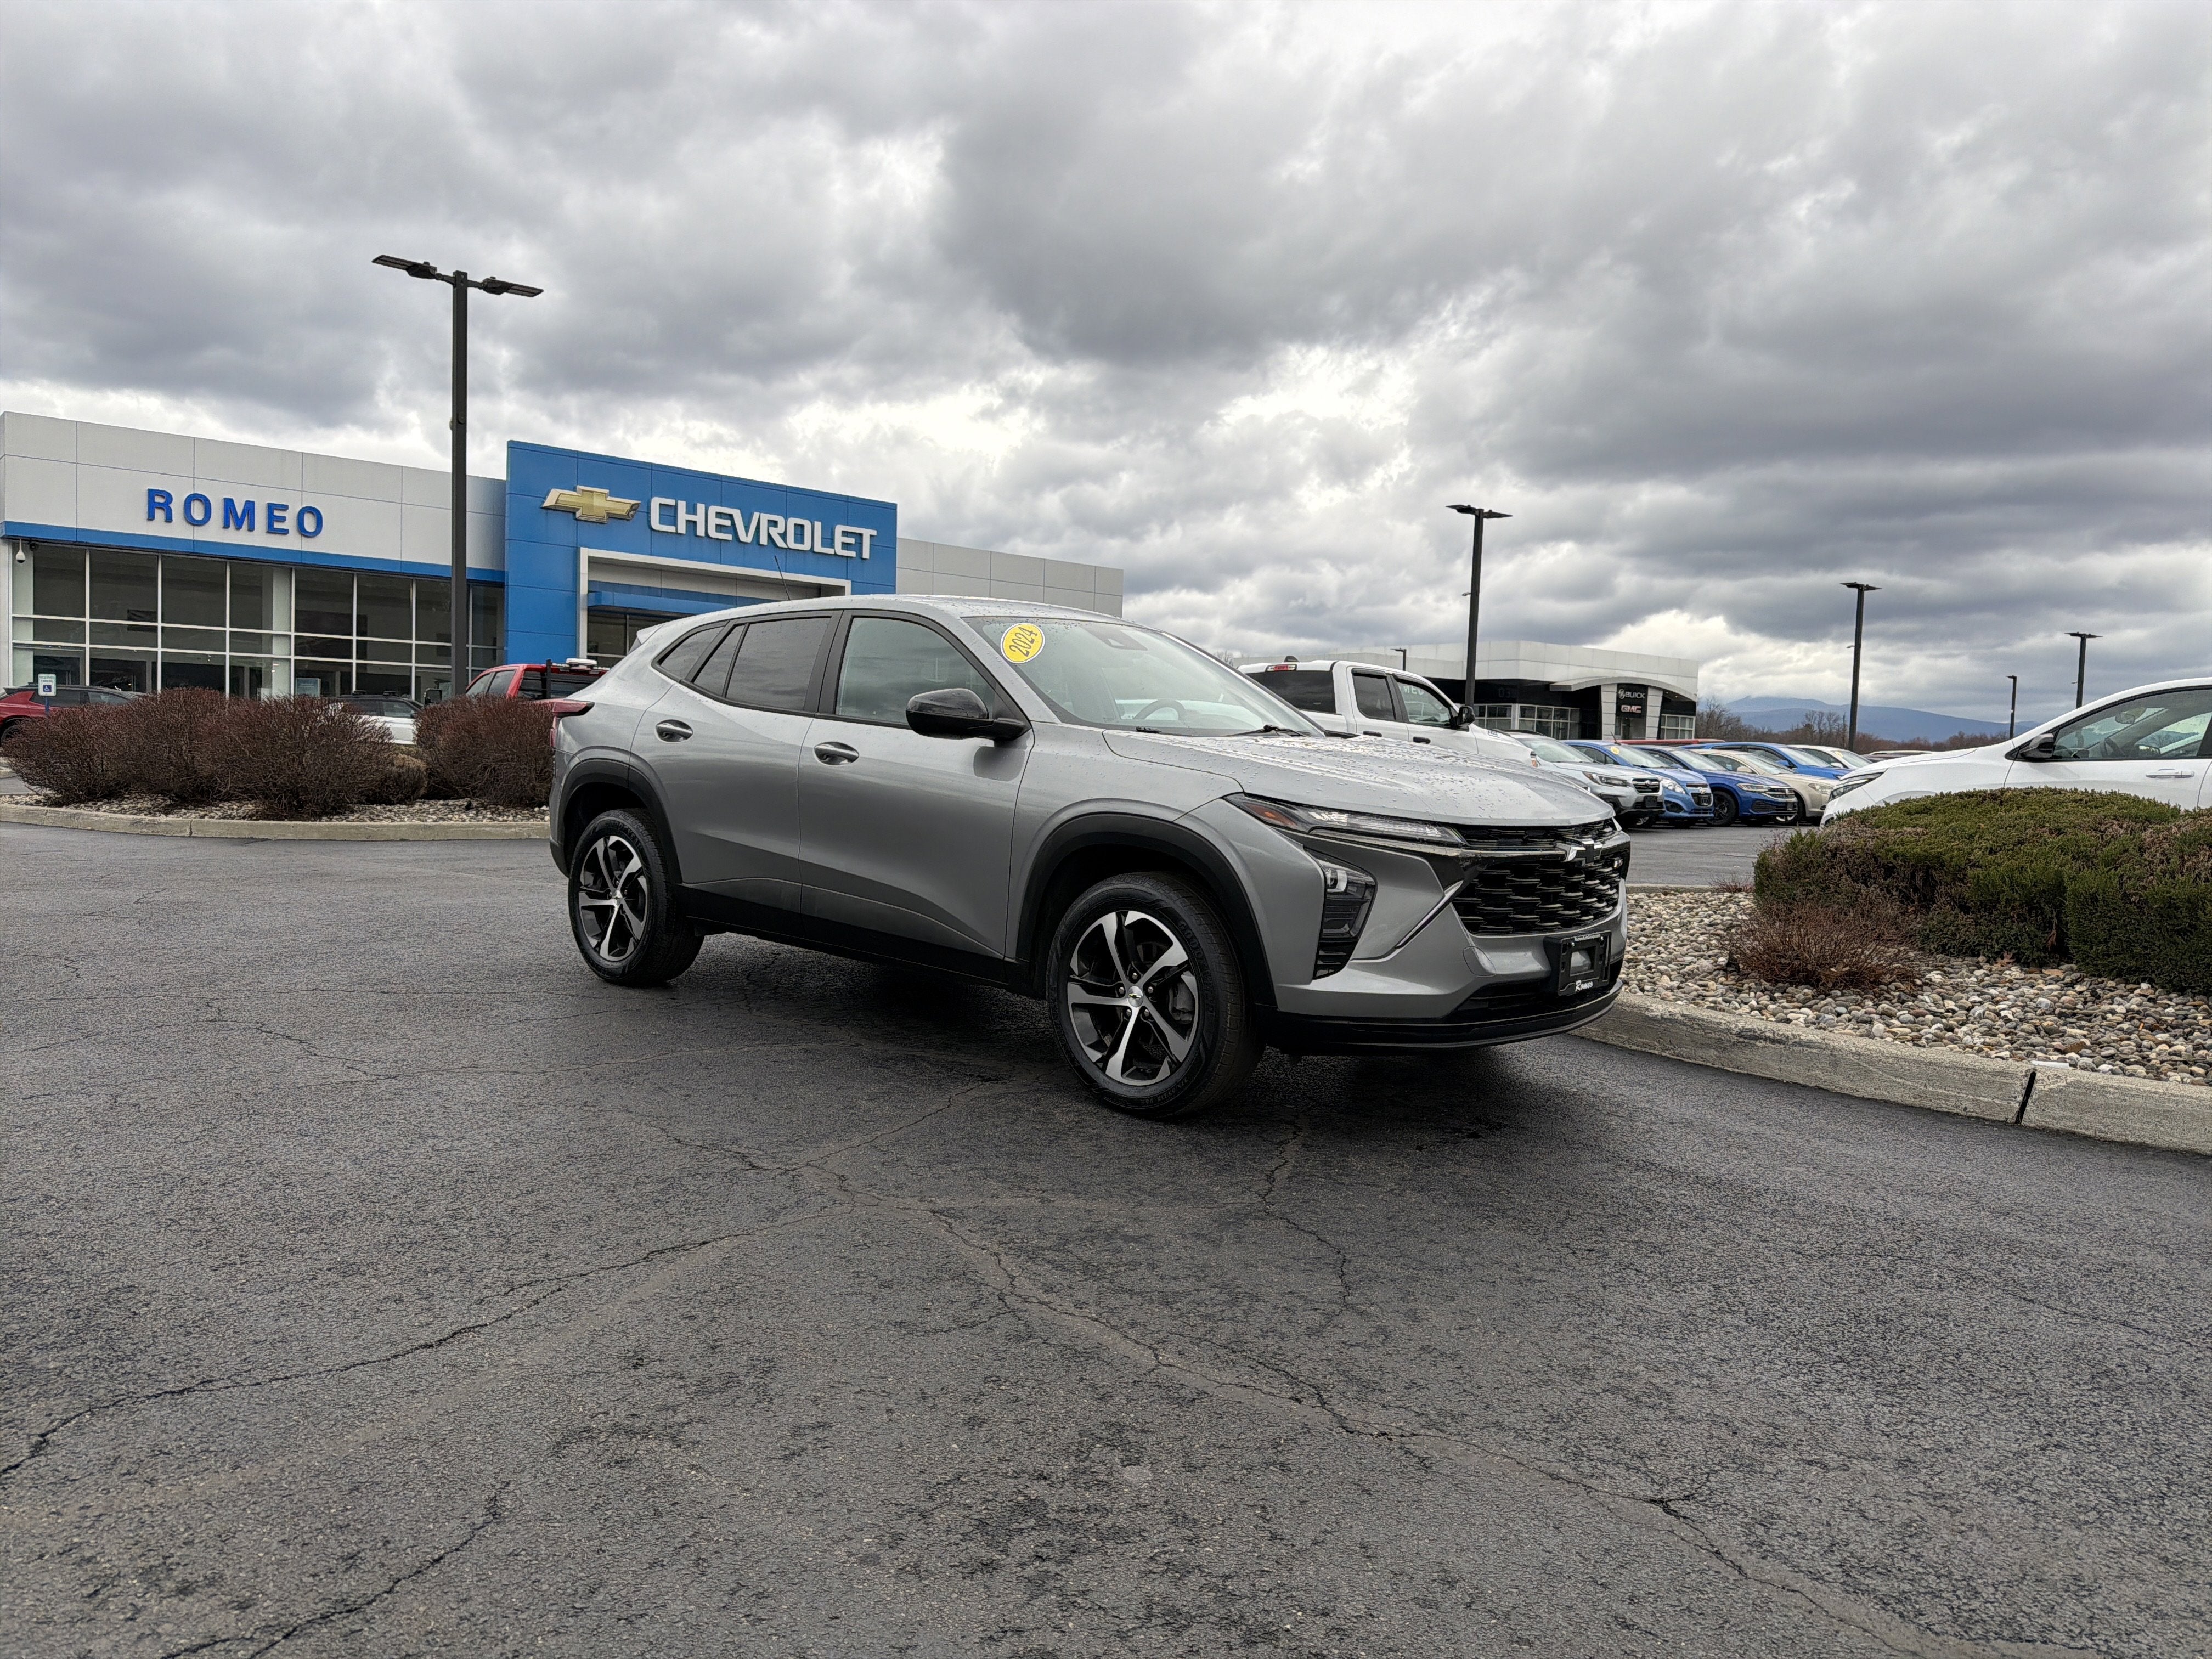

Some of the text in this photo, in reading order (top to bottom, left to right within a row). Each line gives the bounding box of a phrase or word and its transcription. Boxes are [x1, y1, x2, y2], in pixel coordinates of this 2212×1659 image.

[147, 488, 323, 538] ROMEO
[650, 496, 877, 560] CHEVROLET
[1009, 626, 1038, 657] 2024
[1621, 704, 1642, 713] GMC
[1575, 980, 1593, 992] Romeo
